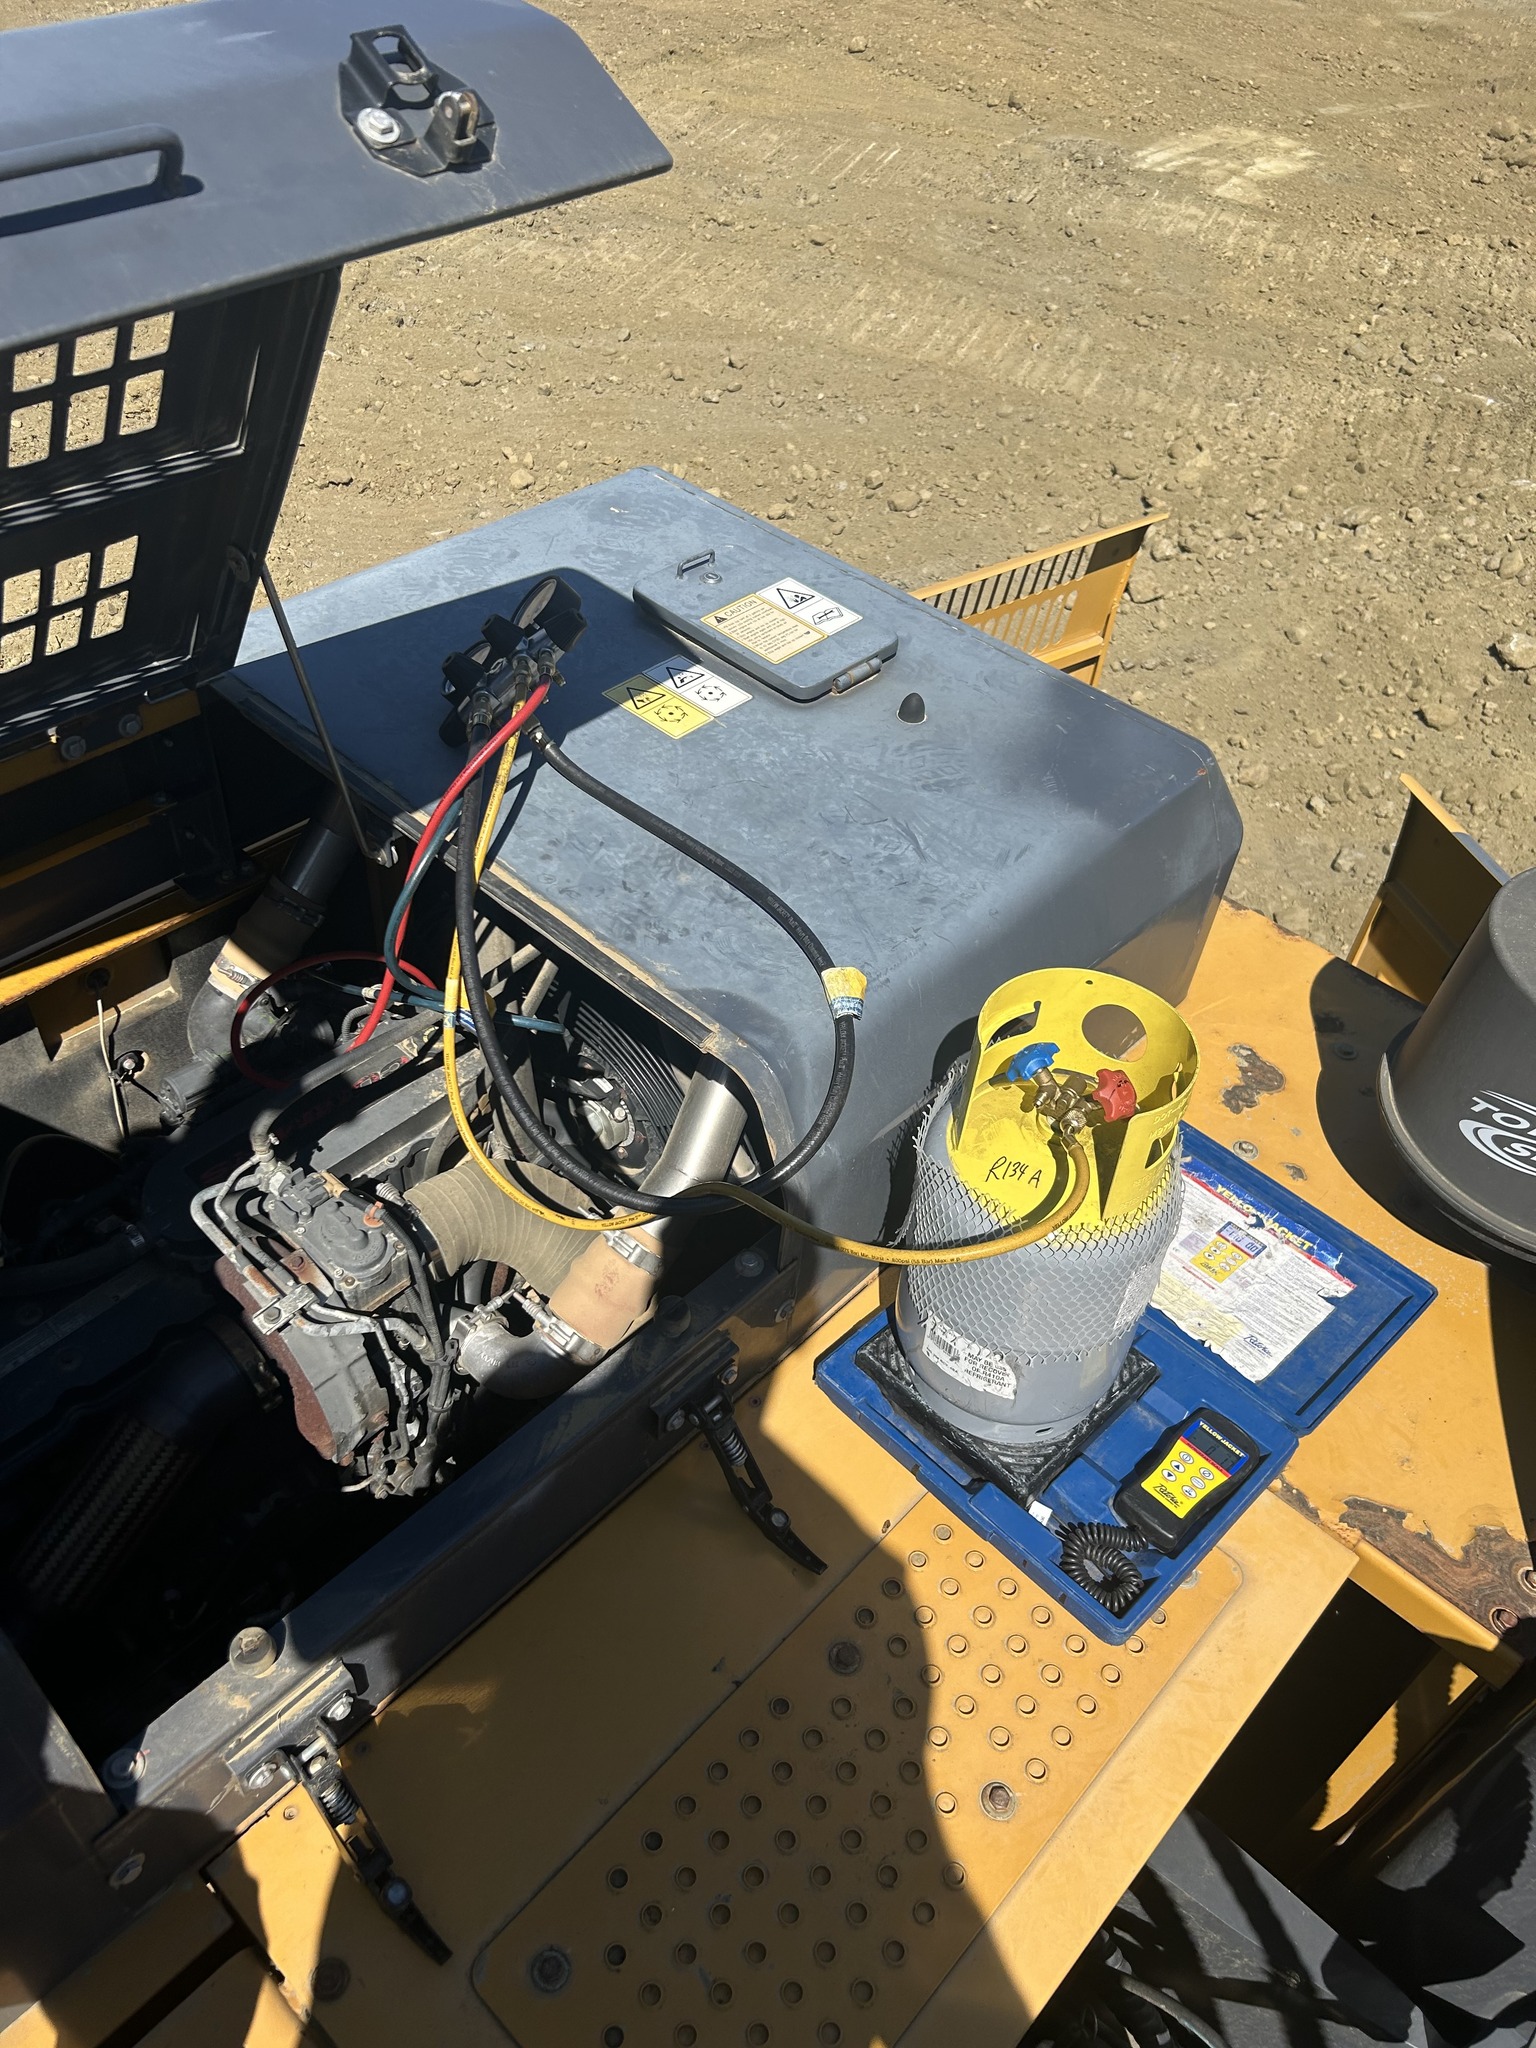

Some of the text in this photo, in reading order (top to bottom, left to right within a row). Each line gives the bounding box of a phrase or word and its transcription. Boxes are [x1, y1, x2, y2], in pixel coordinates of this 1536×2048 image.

[724, 599, 757, 617] CAUTION
[985, 1156, 1043, 1189] R134 A
[964, 1356, 978, 1366] FOR
[967, 1352, 982, 1362] MAY
[964, 1368, 1011, 1388] REFRIGERANT
[1198, 1421, 1222, 1440] YELLOW
